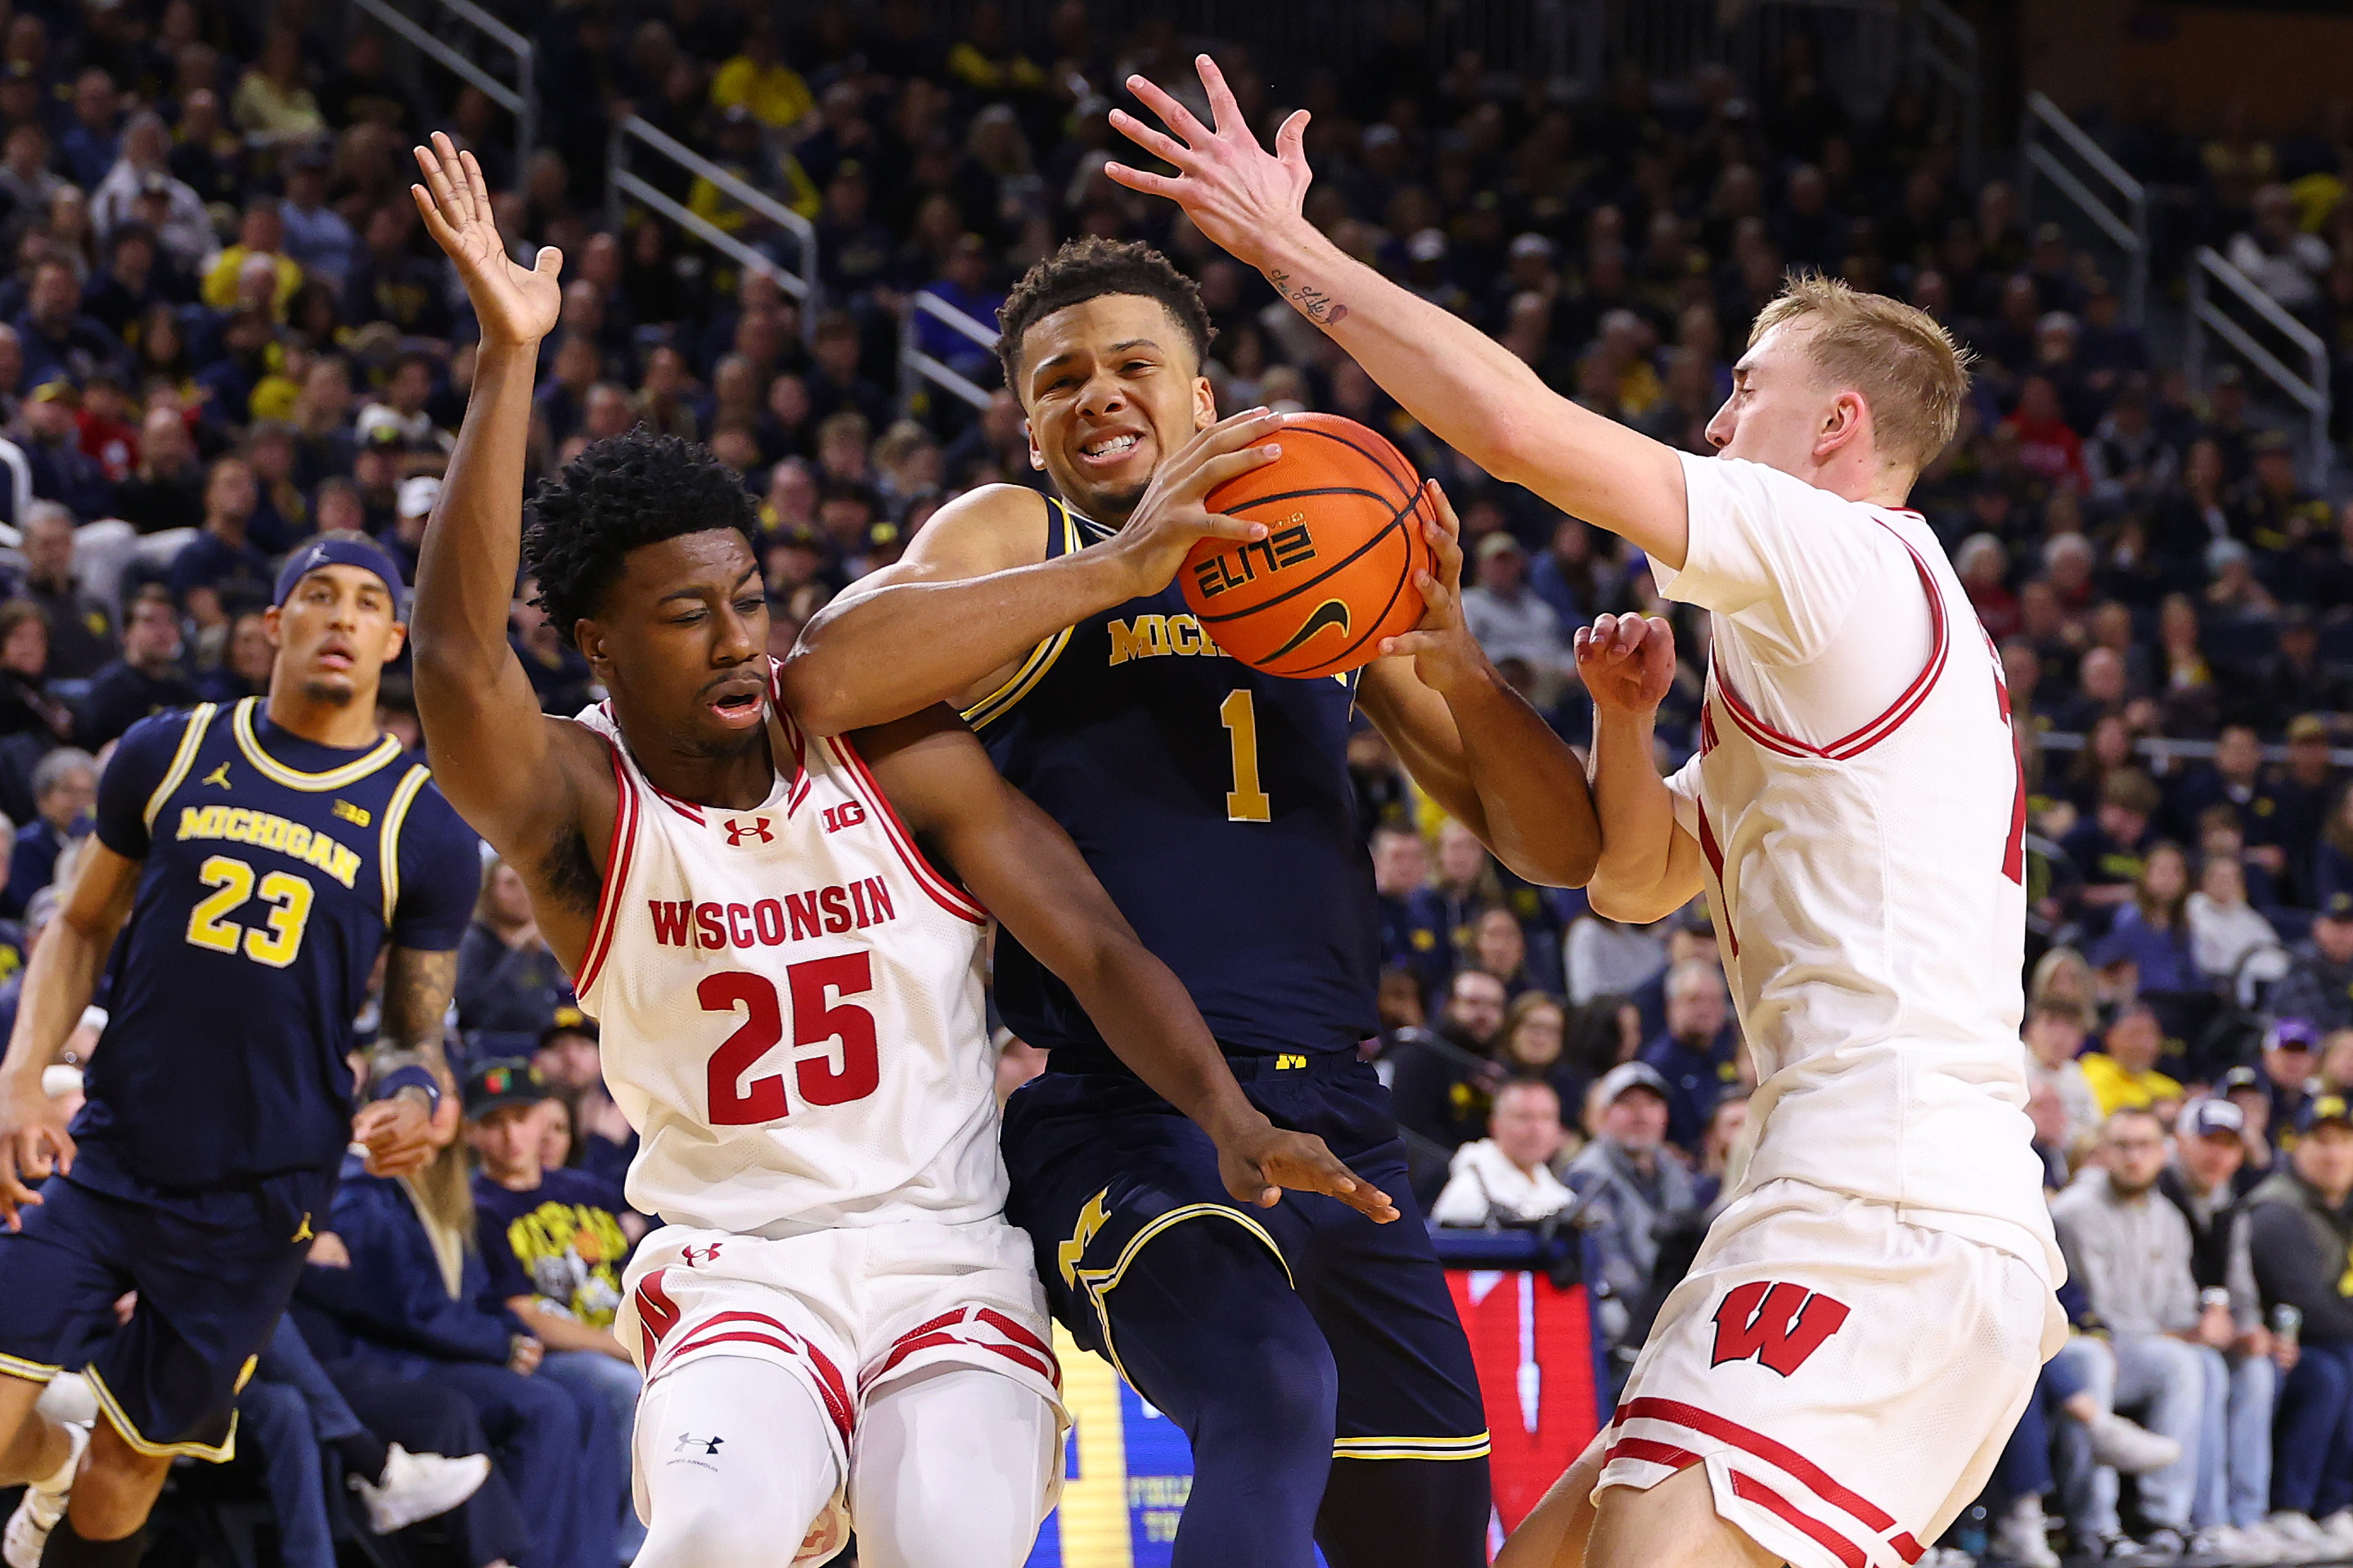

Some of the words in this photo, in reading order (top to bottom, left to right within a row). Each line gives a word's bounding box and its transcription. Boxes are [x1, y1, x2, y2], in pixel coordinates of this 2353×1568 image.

[1194, 523, 1318, 599] ELITE
[1219, 689, 1271, 823] 1
[175, 805, 362, 889] MICHIGAN
[185, 854, 315, 969] 23
[648, 875, 896, 950] WSCONSIN
[697, 950, 880, 1125] 25
[1710, 1281, 1851, 1377] W
